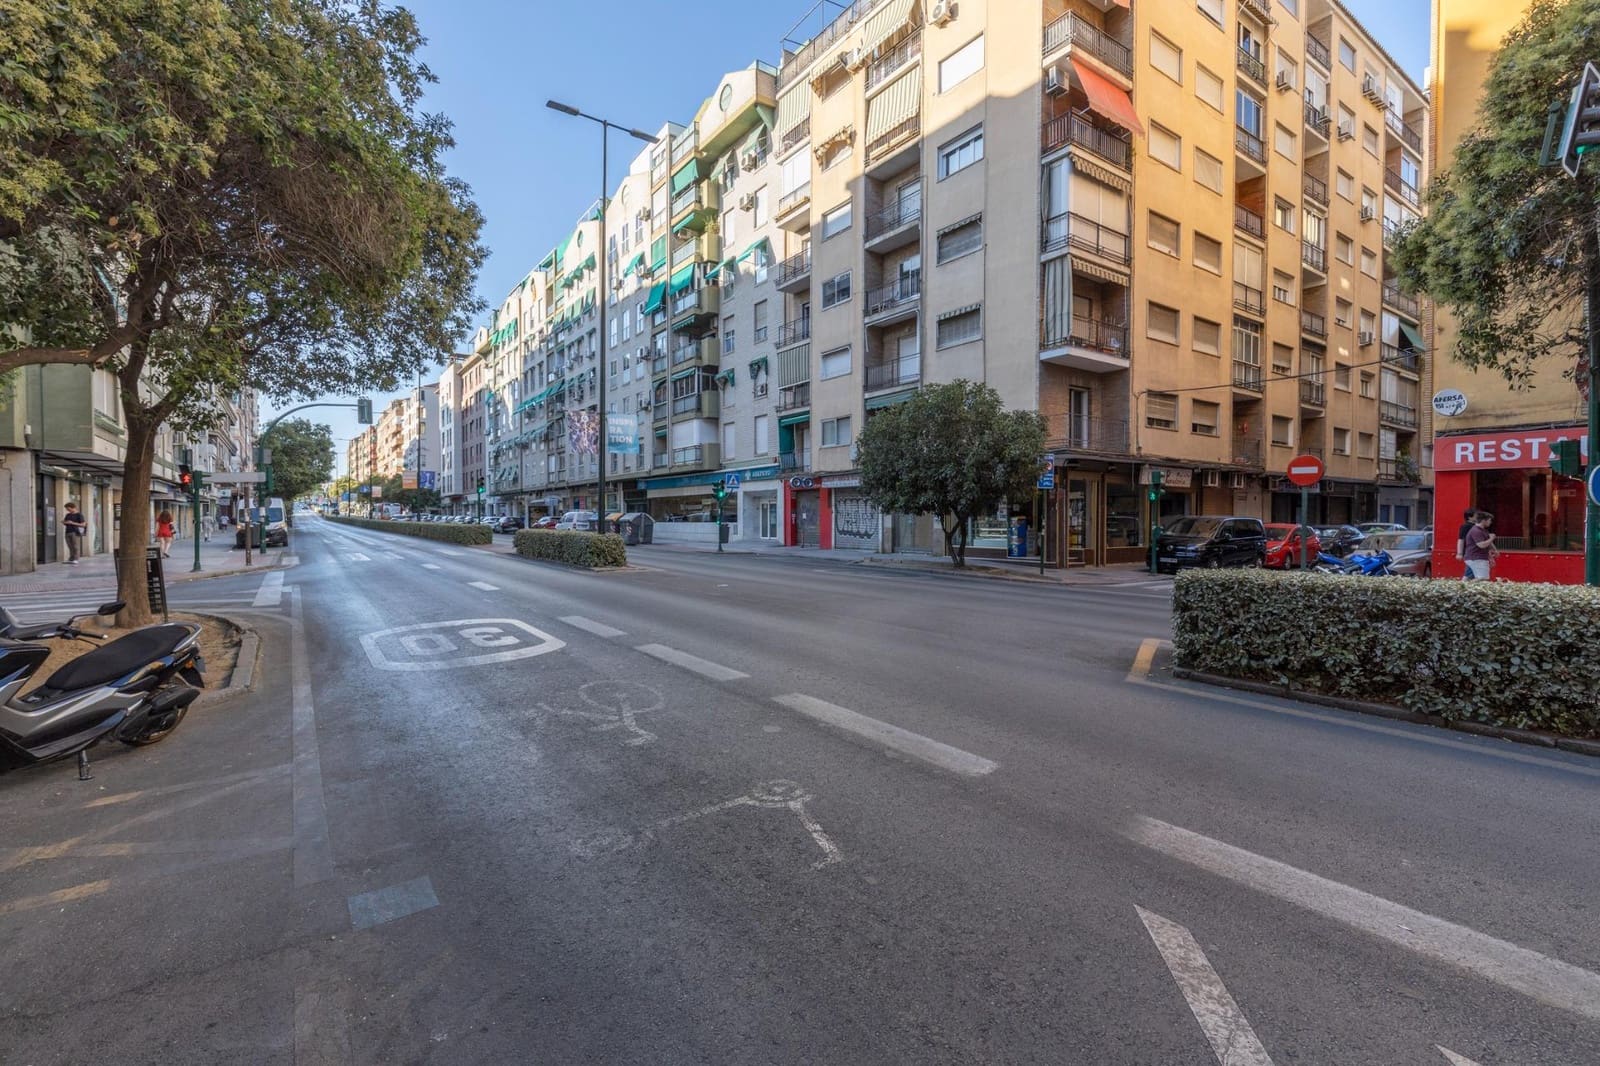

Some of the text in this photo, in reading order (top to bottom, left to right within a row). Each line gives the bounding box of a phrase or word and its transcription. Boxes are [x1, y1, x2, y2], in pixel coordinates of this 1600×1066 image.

[609, 426, 623, 434] RA
[609, 435, 633, 444] TION
[1455, 435, 1588, 463] REST
